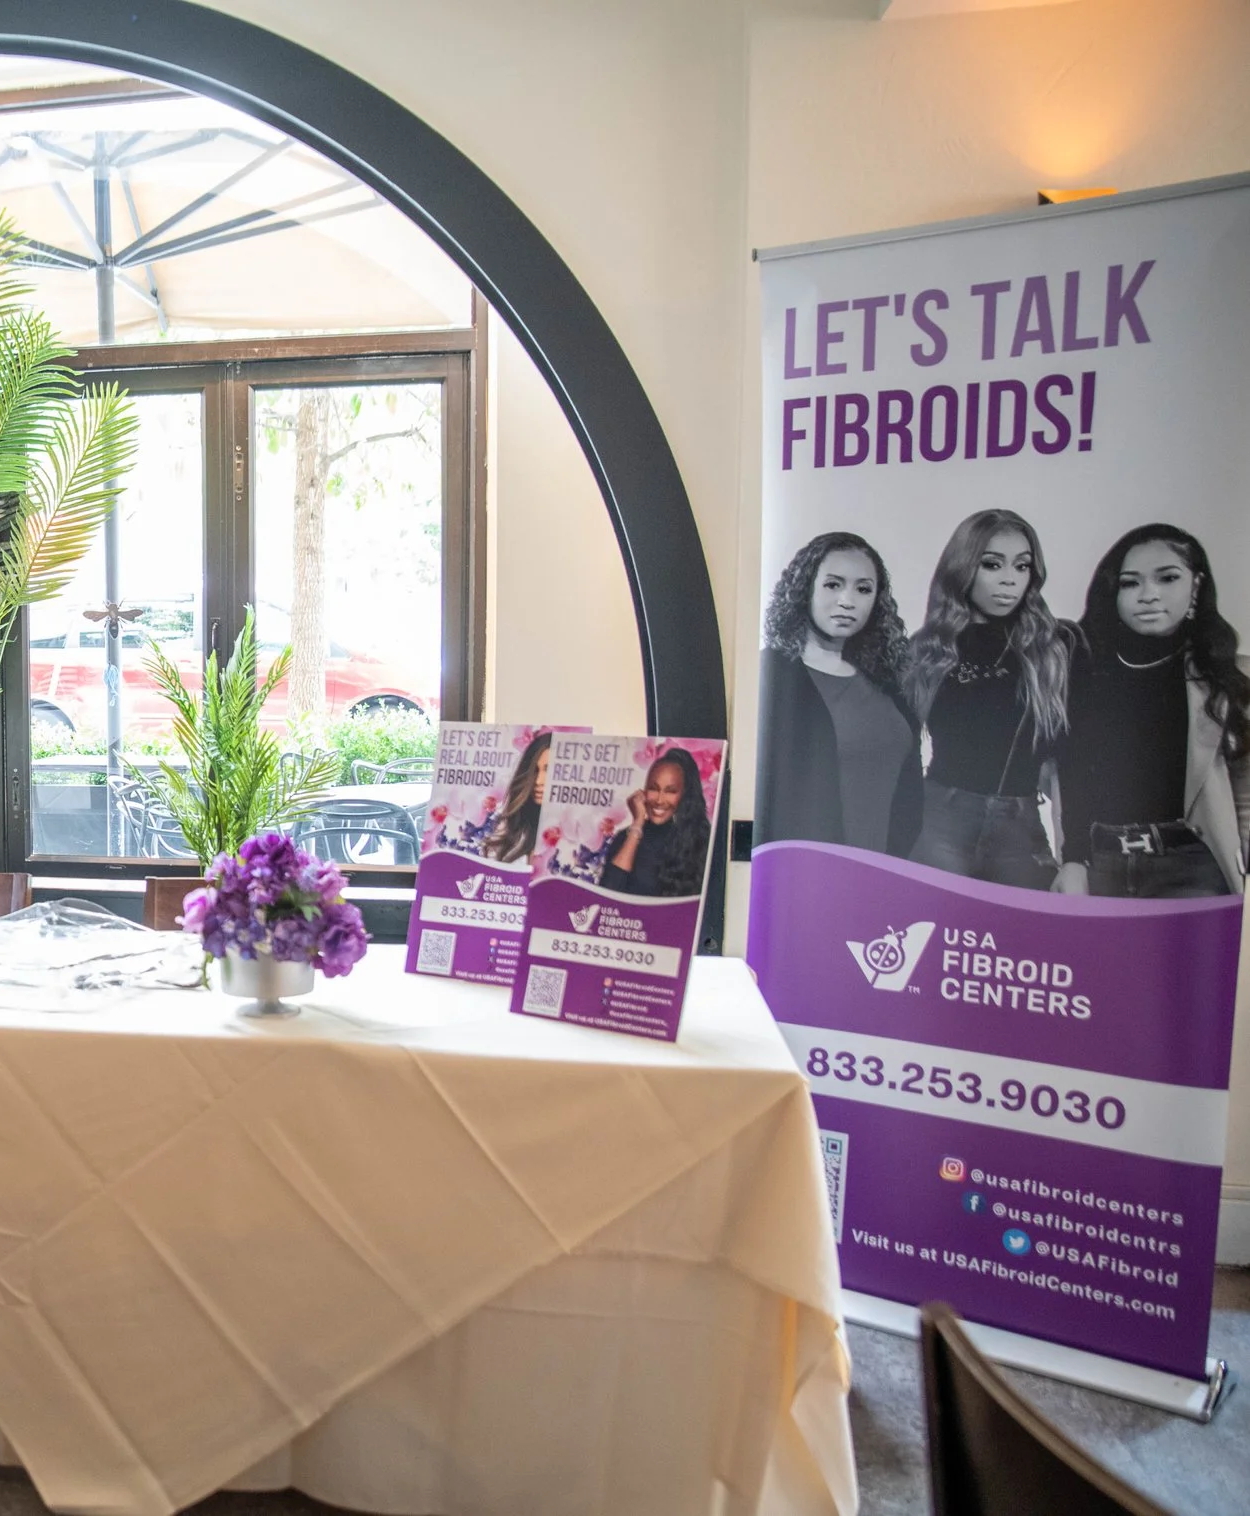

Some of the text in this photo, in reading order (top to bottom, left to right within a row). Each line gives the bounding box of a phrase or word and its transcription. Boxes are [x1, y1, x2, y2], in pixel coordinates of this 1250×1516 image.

[784, 259, 1156, 380] LET'S TALK
[782, 371, 1097, 471] FIBROIDS!
[442, 729, 501, 747] LET'S GET
[439, 749, 514, 768] REAL ABOUT
[555, 741, 620, 762] LET'S GET
[436, 768, 496, 787] FIBROIDS!
[552, 763, 635, 786] REAL ABOUT
[549, 784, 614, 807] FIBROIDS!
[484, 883, 524, 895] FIBROID
[485, 875, 503, 883] USA
[482, 892, 527, 905] CENTERS
[599, 915, 643, 931] FIBROID
[601, 907, 620, 916] USA
[597, 925, 647, 942] CENTERS
[942, 927, 997, 950] USA
[551, 938, 655, 966] 833.253.9030
[941, 950, 1074, 988] FIBROID
[940, 977, 1092, 1020] CENTERS
[806, 1046, 1127, 1131] 833.253.9030
[971, 1168, 1184, 1226] @usafibroidcenters
[992, 1202, 1181, 1257] @usafibroidcntrs
[852, 1229, 1176, 1321] Visit us at USAFibroidCenters.com
[1035, 1241, 1178, 1288] @USAFibroid
